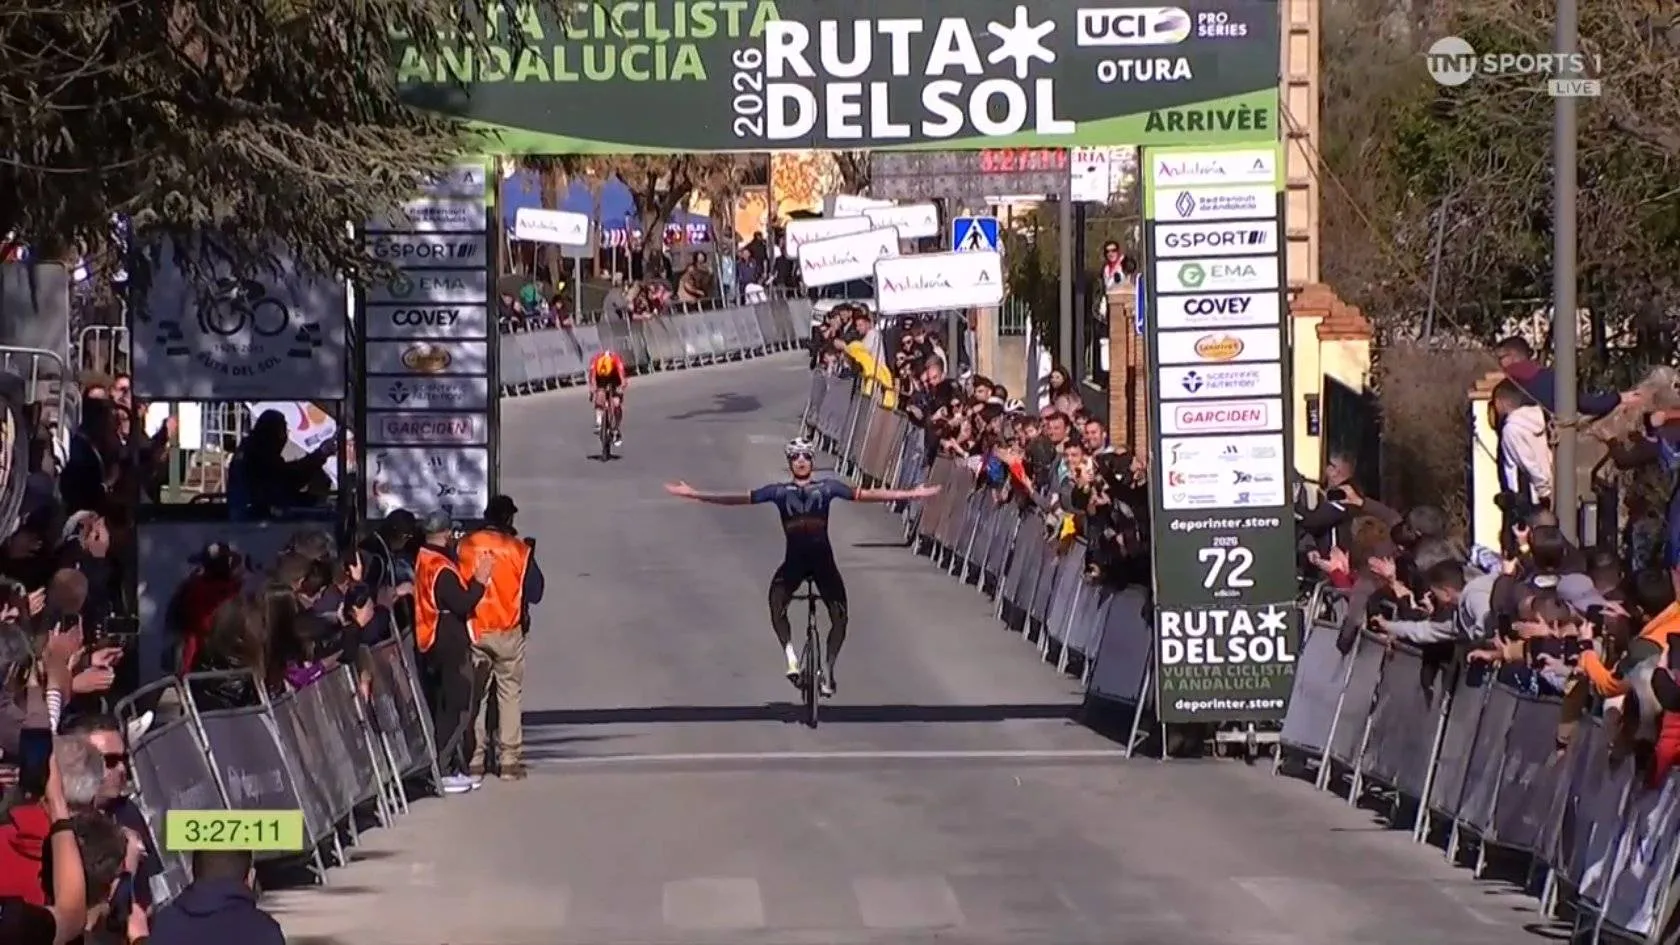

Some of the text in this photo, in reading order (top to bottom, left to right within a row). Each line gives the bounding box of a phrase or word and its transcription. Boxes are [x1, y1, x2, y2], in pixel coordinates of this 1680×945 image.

[1084, 15, 1146, 38] UCI
[1198, 12, 1228, 25] PRO
[1198, 24, 1248, 37] SERIES
[766, 18, 984, 78] RUTA
[1097, 57, 1193, 83] OTURA
[732, 47, 763, 138] 2026
[766, 78, 1076, 140] DEL SOL
[1144, 103, 1269, 132] ARRIVÈE
[1165, 230, 1248, 248] GSPORT
[375, 243, 459, 259] GSPORT
[1211, 264, 1257, 278] EMA
[420, 277, 465, 290] EMA
[1184, 296, 1252, 316] COVEY
[391, 309, 460, 327] COVEY
[1182, 409, 1261, 424] GARCIDEN
[1170, 517, 1280, 532] deporinter.store
[1213, 536, 1239, 547] 2026
[1199, 547, 1255, 588] 72
[1161, 610, 1255, 637] RUTA
[1162, 636, 1295, 664] DEL SOL
[1163, 663, 1294, 679] VUELTA CICLISTA
[1163, 679, 1174, 691] A
[1175, 698, 1284, 712] deporinter.store
